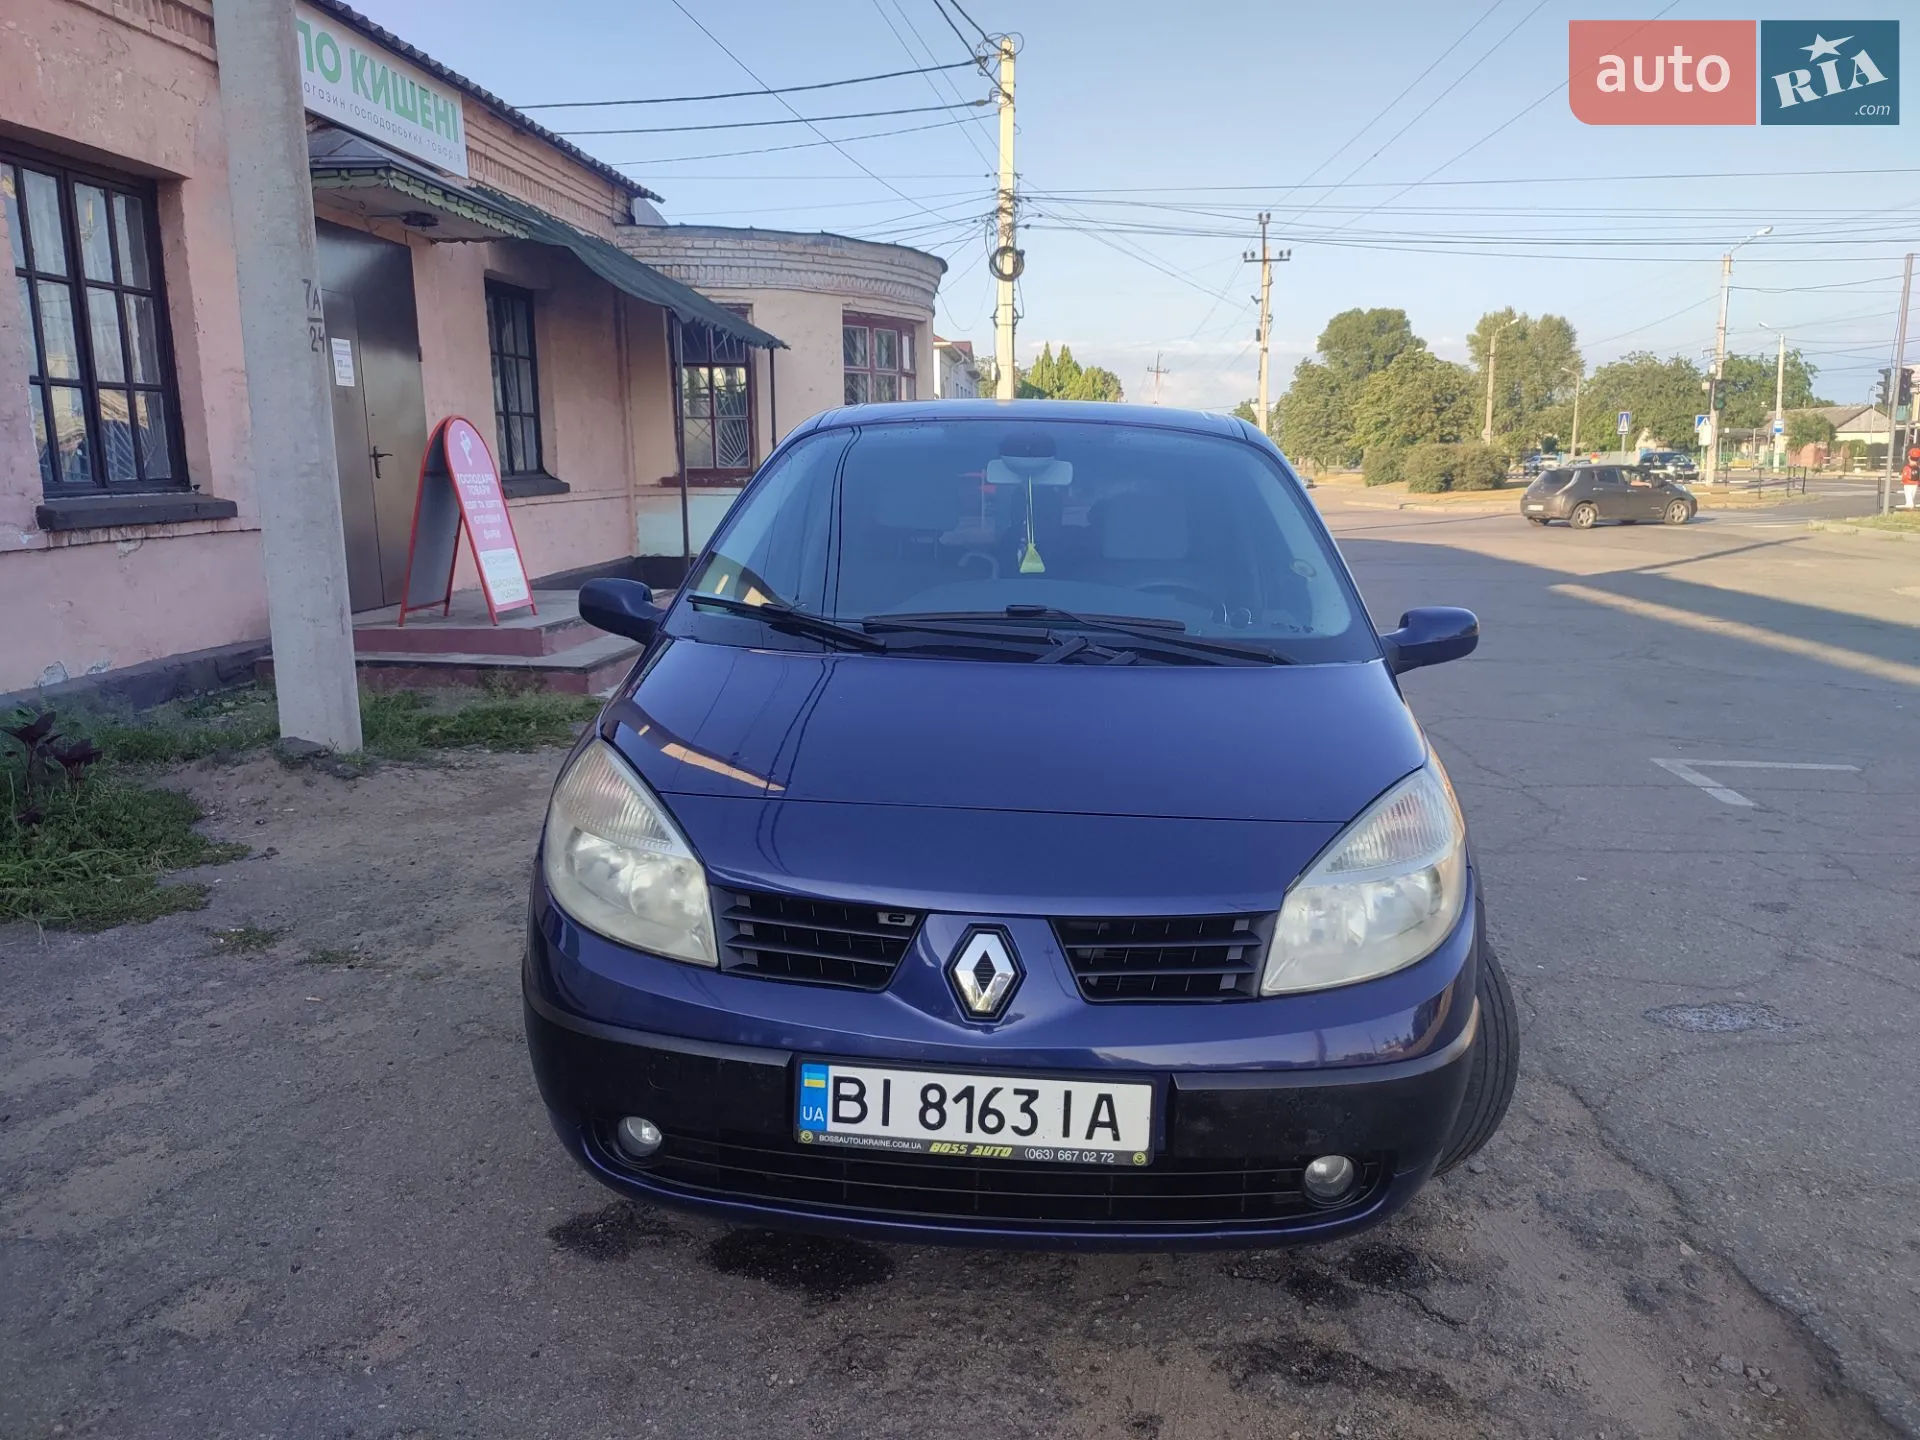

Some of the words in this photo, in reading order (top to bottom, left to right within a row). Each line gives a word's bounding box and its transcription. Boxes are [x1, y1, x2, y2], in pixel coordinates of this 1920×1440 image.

[302, 80, 347, 110] агазин
[349, 104, 424, 145] господарських
[350, 47, 459, 144] КИШЕНІ
[309, 325, 326, 354] 24
[802, 1106, 826, 1123] UA
[831, 1075, 891, 1127] BI
[918, 1083, 1040, 1135] 8163
[1062, 1089, 1122, 1142] IA
[818, 1134, 922, 1150] BOSSAUTOUKRAINE.COM.UA
[929, 1141, 968, 1155] BOSS
[1024, 1147, 1054, 1160] (063)
[1057, 1150, 1079, 1162] 667
[1082, 1151, 1097, 1162] 02
[1100, 1152, 1115, 1163] 72
